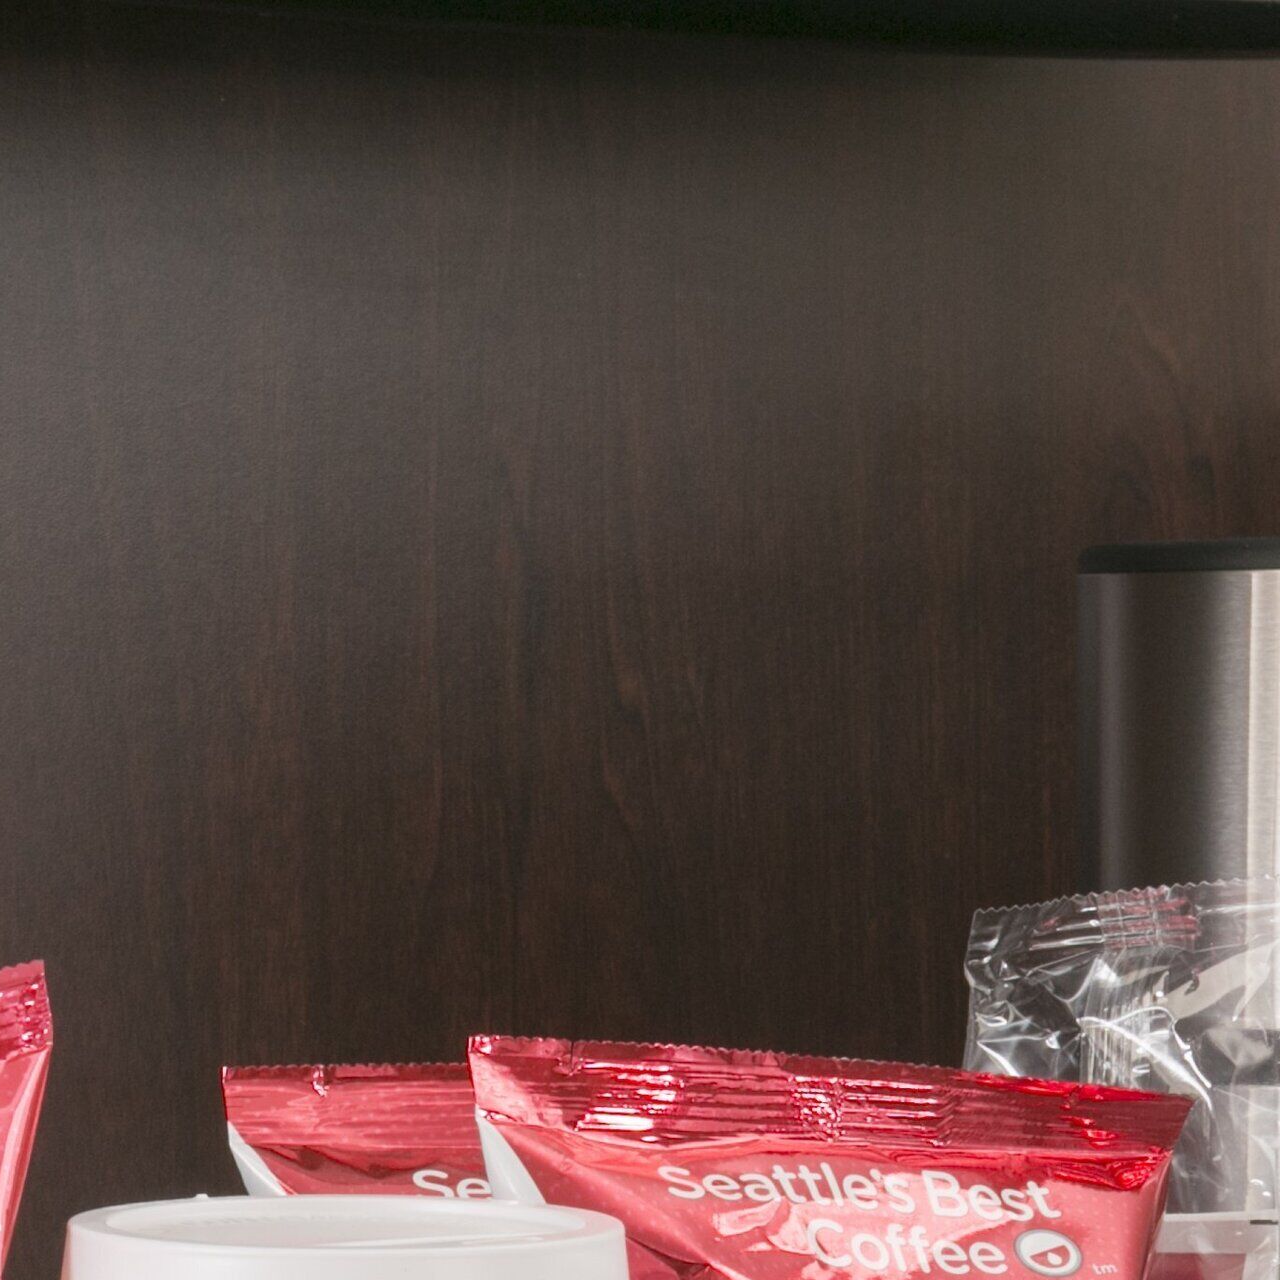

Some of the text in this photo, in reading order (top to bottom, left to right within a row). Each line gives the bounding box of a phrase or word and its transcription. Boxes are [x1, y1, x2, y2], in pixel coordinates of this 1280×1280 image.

[658, 1162, 1062, 1222] Seattle's Best
[806, 1217, 1008, 1276] Coffee
